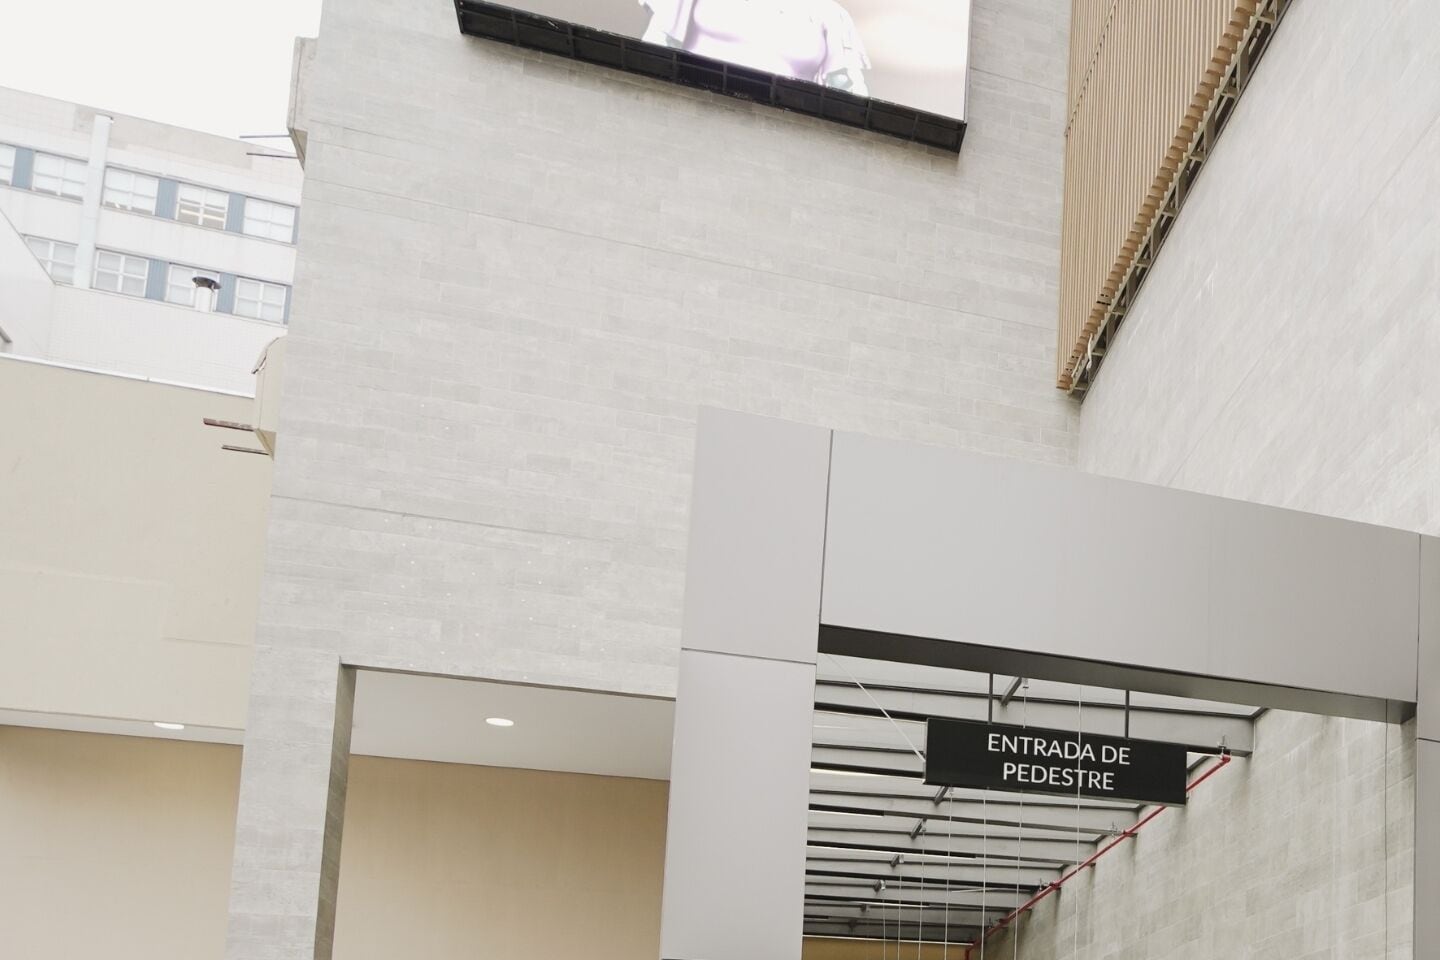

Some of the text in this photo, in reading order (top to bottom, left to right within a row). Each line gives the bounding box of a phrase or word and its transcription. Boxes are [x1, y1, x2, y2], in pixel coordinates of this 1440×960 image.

[987, 733, 1131, 765] ENTRADA DE
[1003, 762, 1115, 790] PEDESTRE
